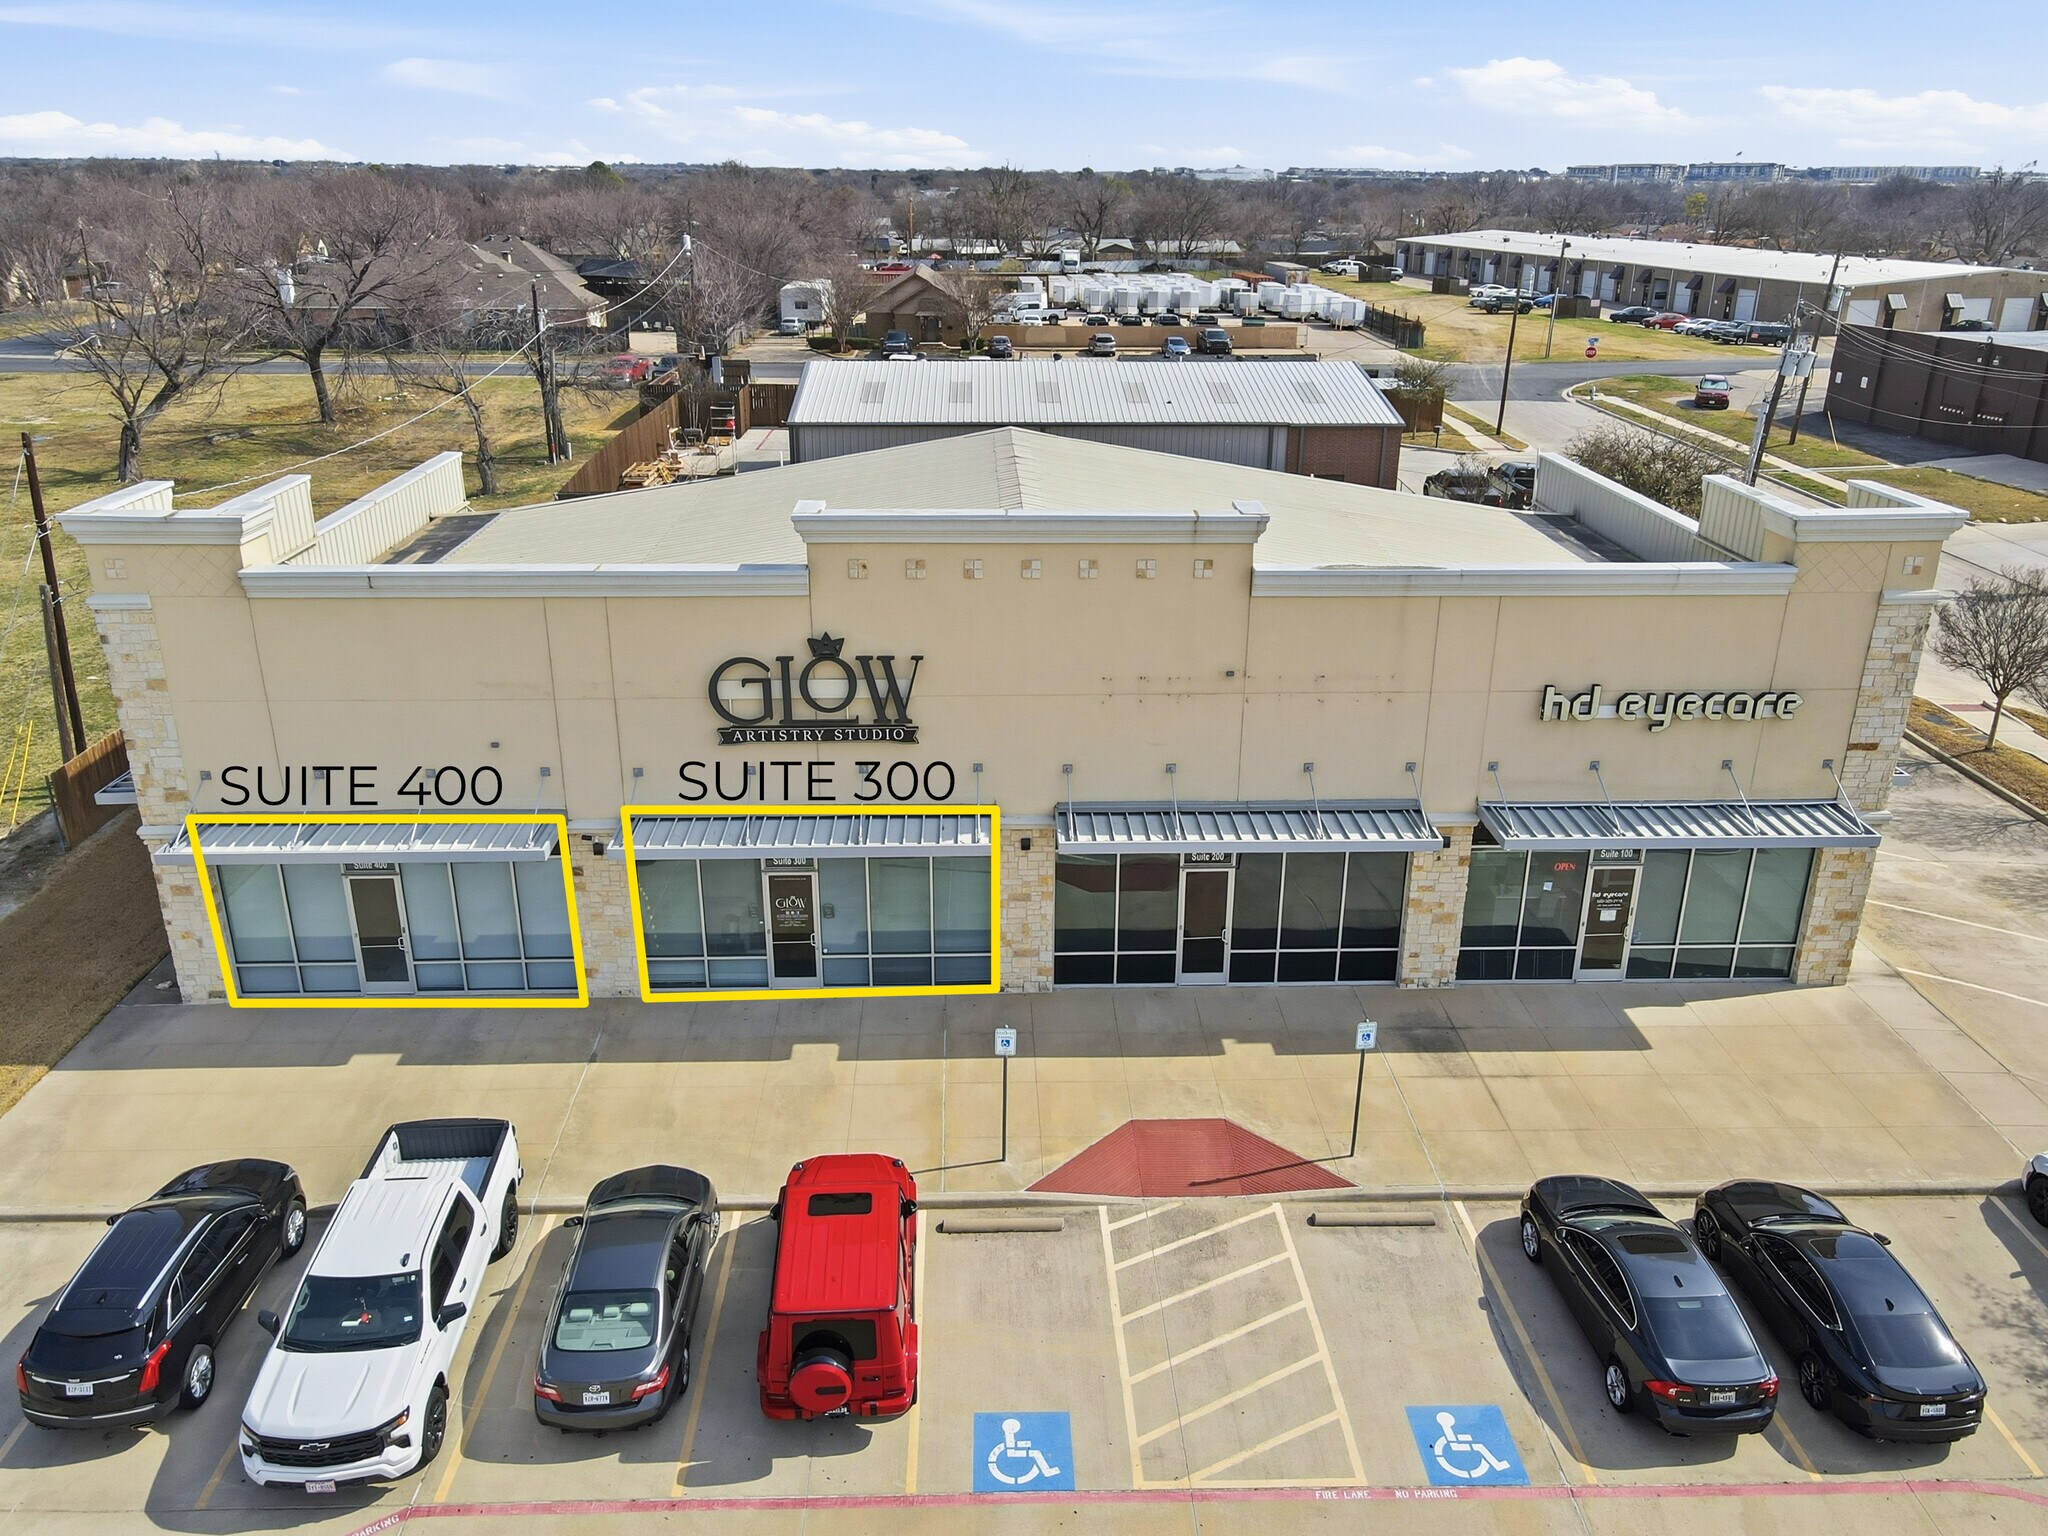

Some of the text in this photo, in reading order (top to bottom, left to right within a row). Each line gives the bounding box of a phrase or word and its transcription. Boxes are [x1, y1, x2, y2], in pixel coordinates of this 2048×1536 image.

[708, 655, 924, 726] GLOW
[1540, 684, 1804, 733] hd eyecare
[733, 728, 905, 742] ARTISTRY STUDIO
[1600, 850, 1633, 858] Suite 100
[1554, 863, 1576, 871] OPEN
[1315, 1490, 1458, 1499] FIRE LANE NO PARKING
